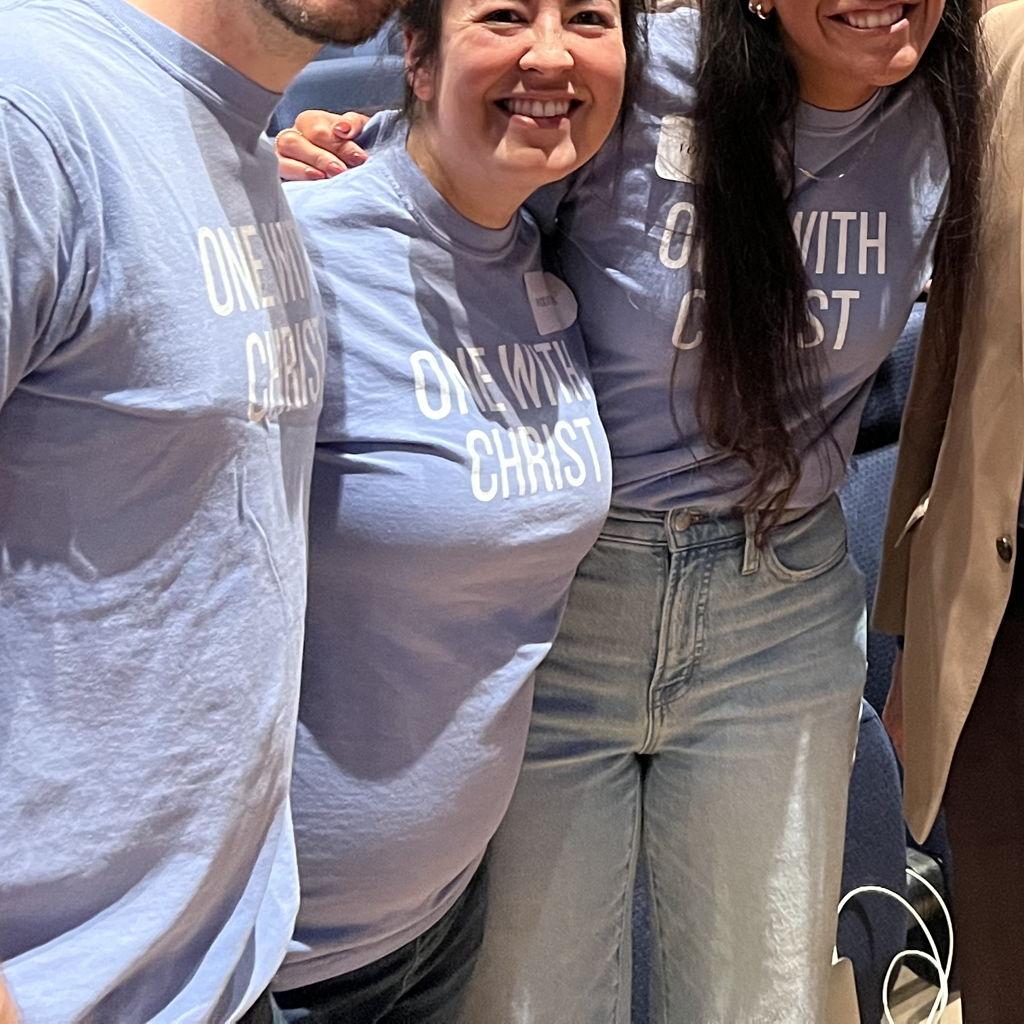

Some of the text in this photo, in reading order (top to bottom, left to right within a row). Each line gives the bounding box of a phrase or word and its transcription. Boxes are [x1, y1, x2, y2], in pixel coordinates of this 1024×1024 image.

[198, 225, 275, 317] ONE
[672, 288, 860, 350] CST
[409, 339, 592, 420] ONE WITH
[466, 417, 601, 502] CHRIST
